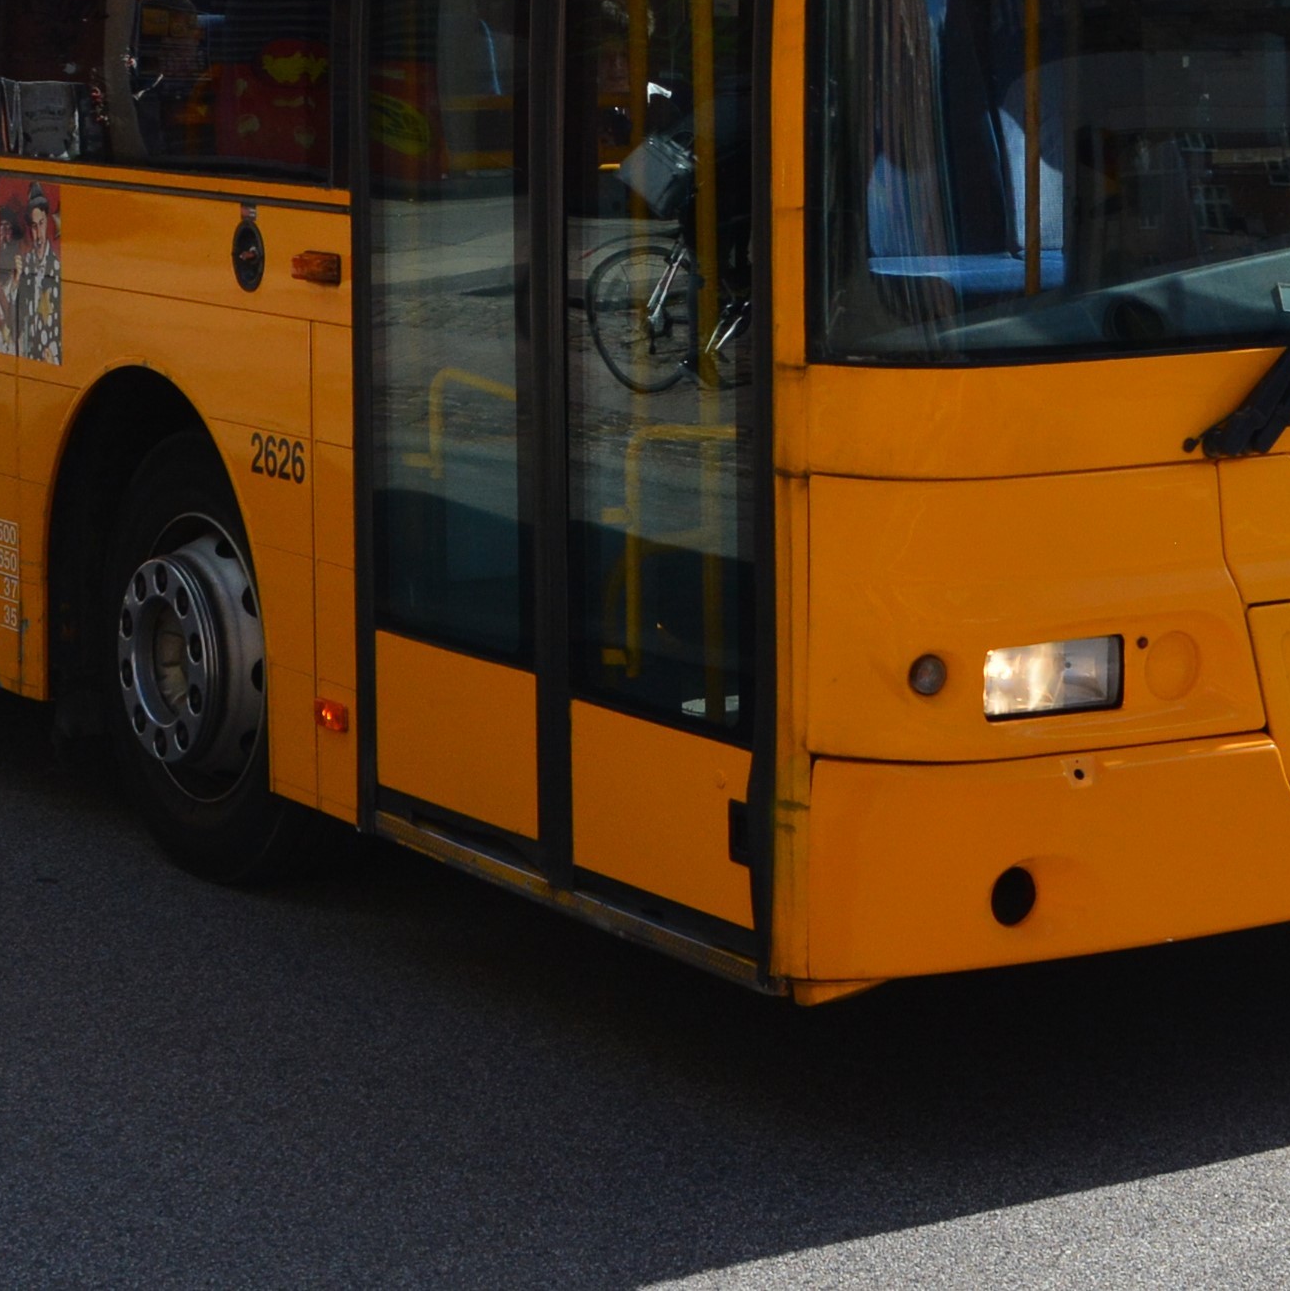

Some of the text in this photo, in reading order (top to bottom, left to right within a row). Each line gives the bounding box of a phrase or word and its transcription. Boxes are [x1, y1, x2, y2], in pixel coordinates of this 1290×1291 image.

[251, 431, 305, 484] 2626
[3, 576, 18, 599] 37
[4, 604, 18, 627] 35
